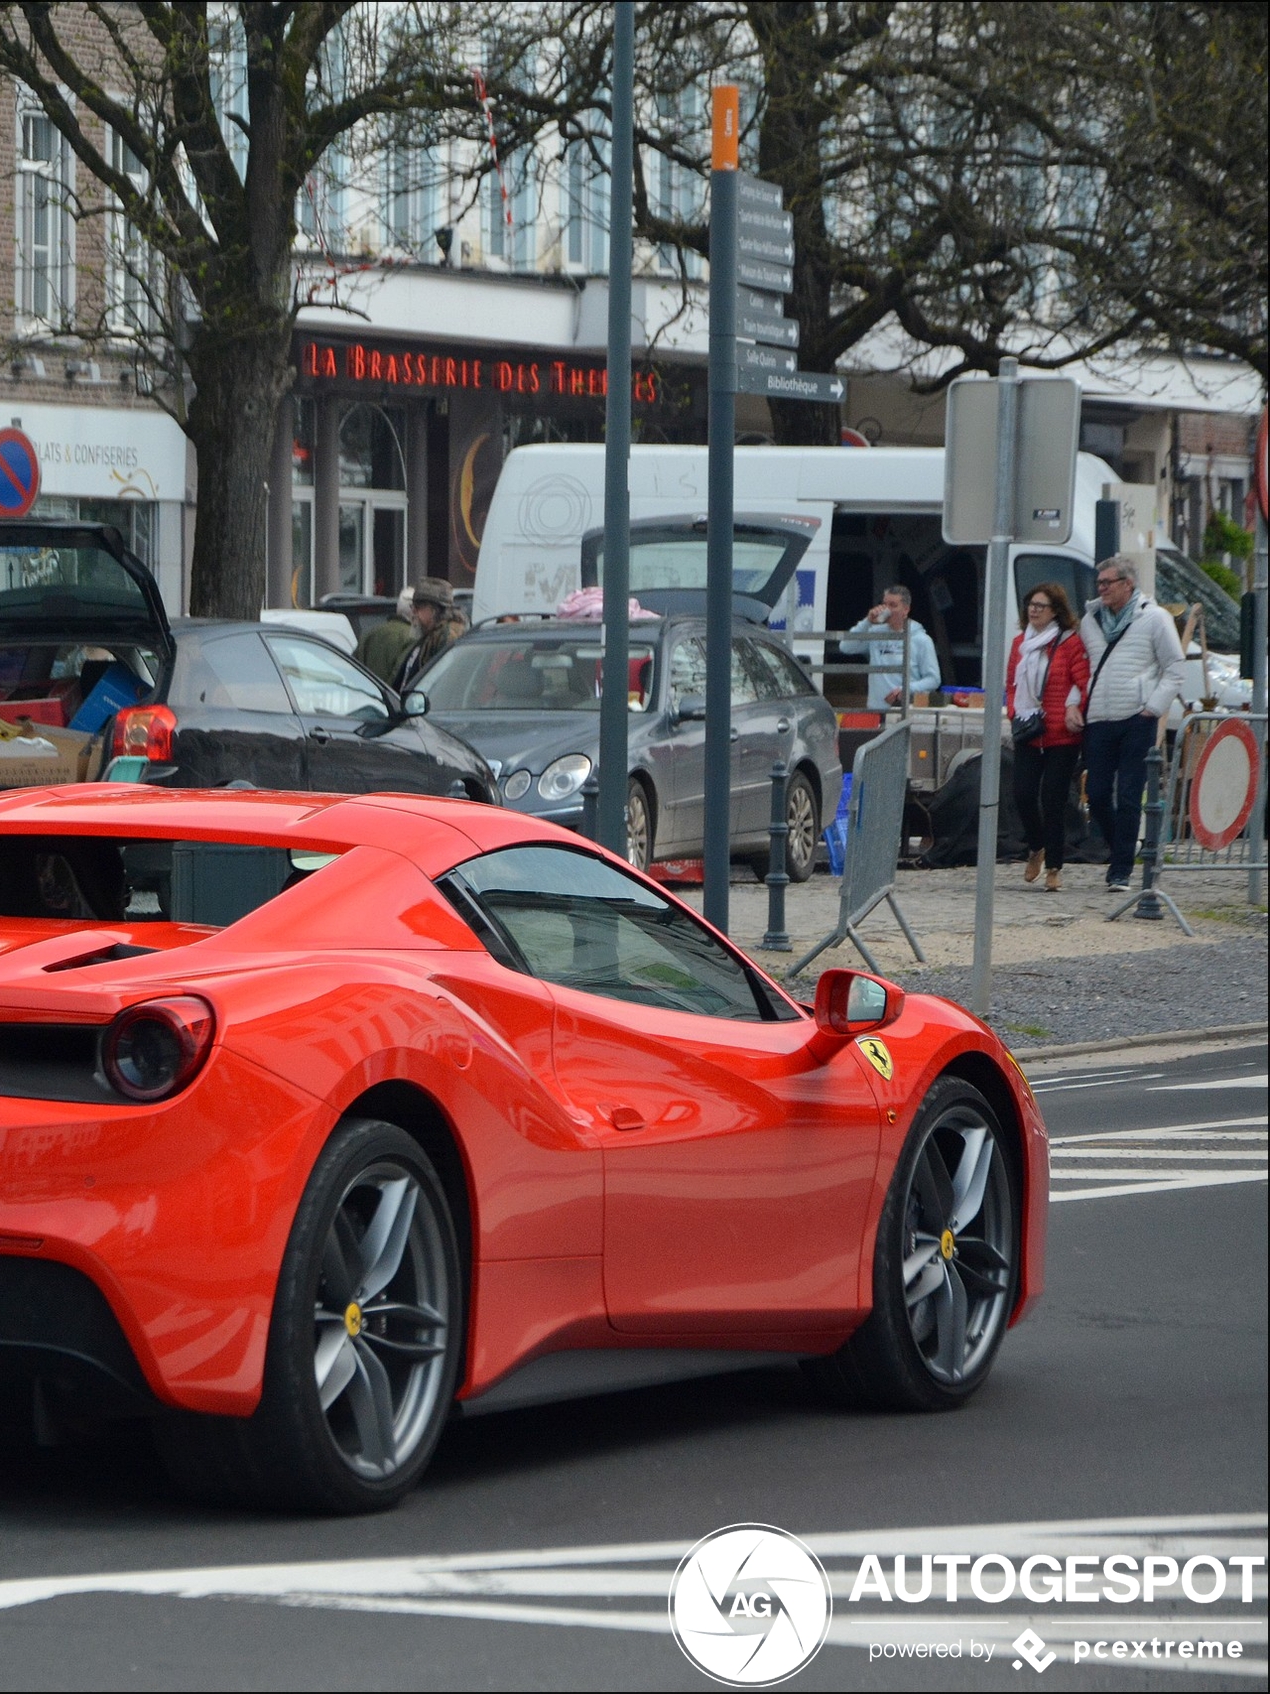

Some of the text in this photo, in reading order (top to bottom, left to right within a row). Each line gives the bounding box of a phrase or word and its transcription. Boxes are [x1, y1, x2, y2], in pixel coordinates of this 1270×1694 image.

[308, 342, 337, 377] LA
[352, 343, 482, 388] BRASSERIE
[497, 361, 542, 392] DES
[767, 375, 818, 394] Bibliothèque
[74, 444, 138, 468] CONFISERIES
